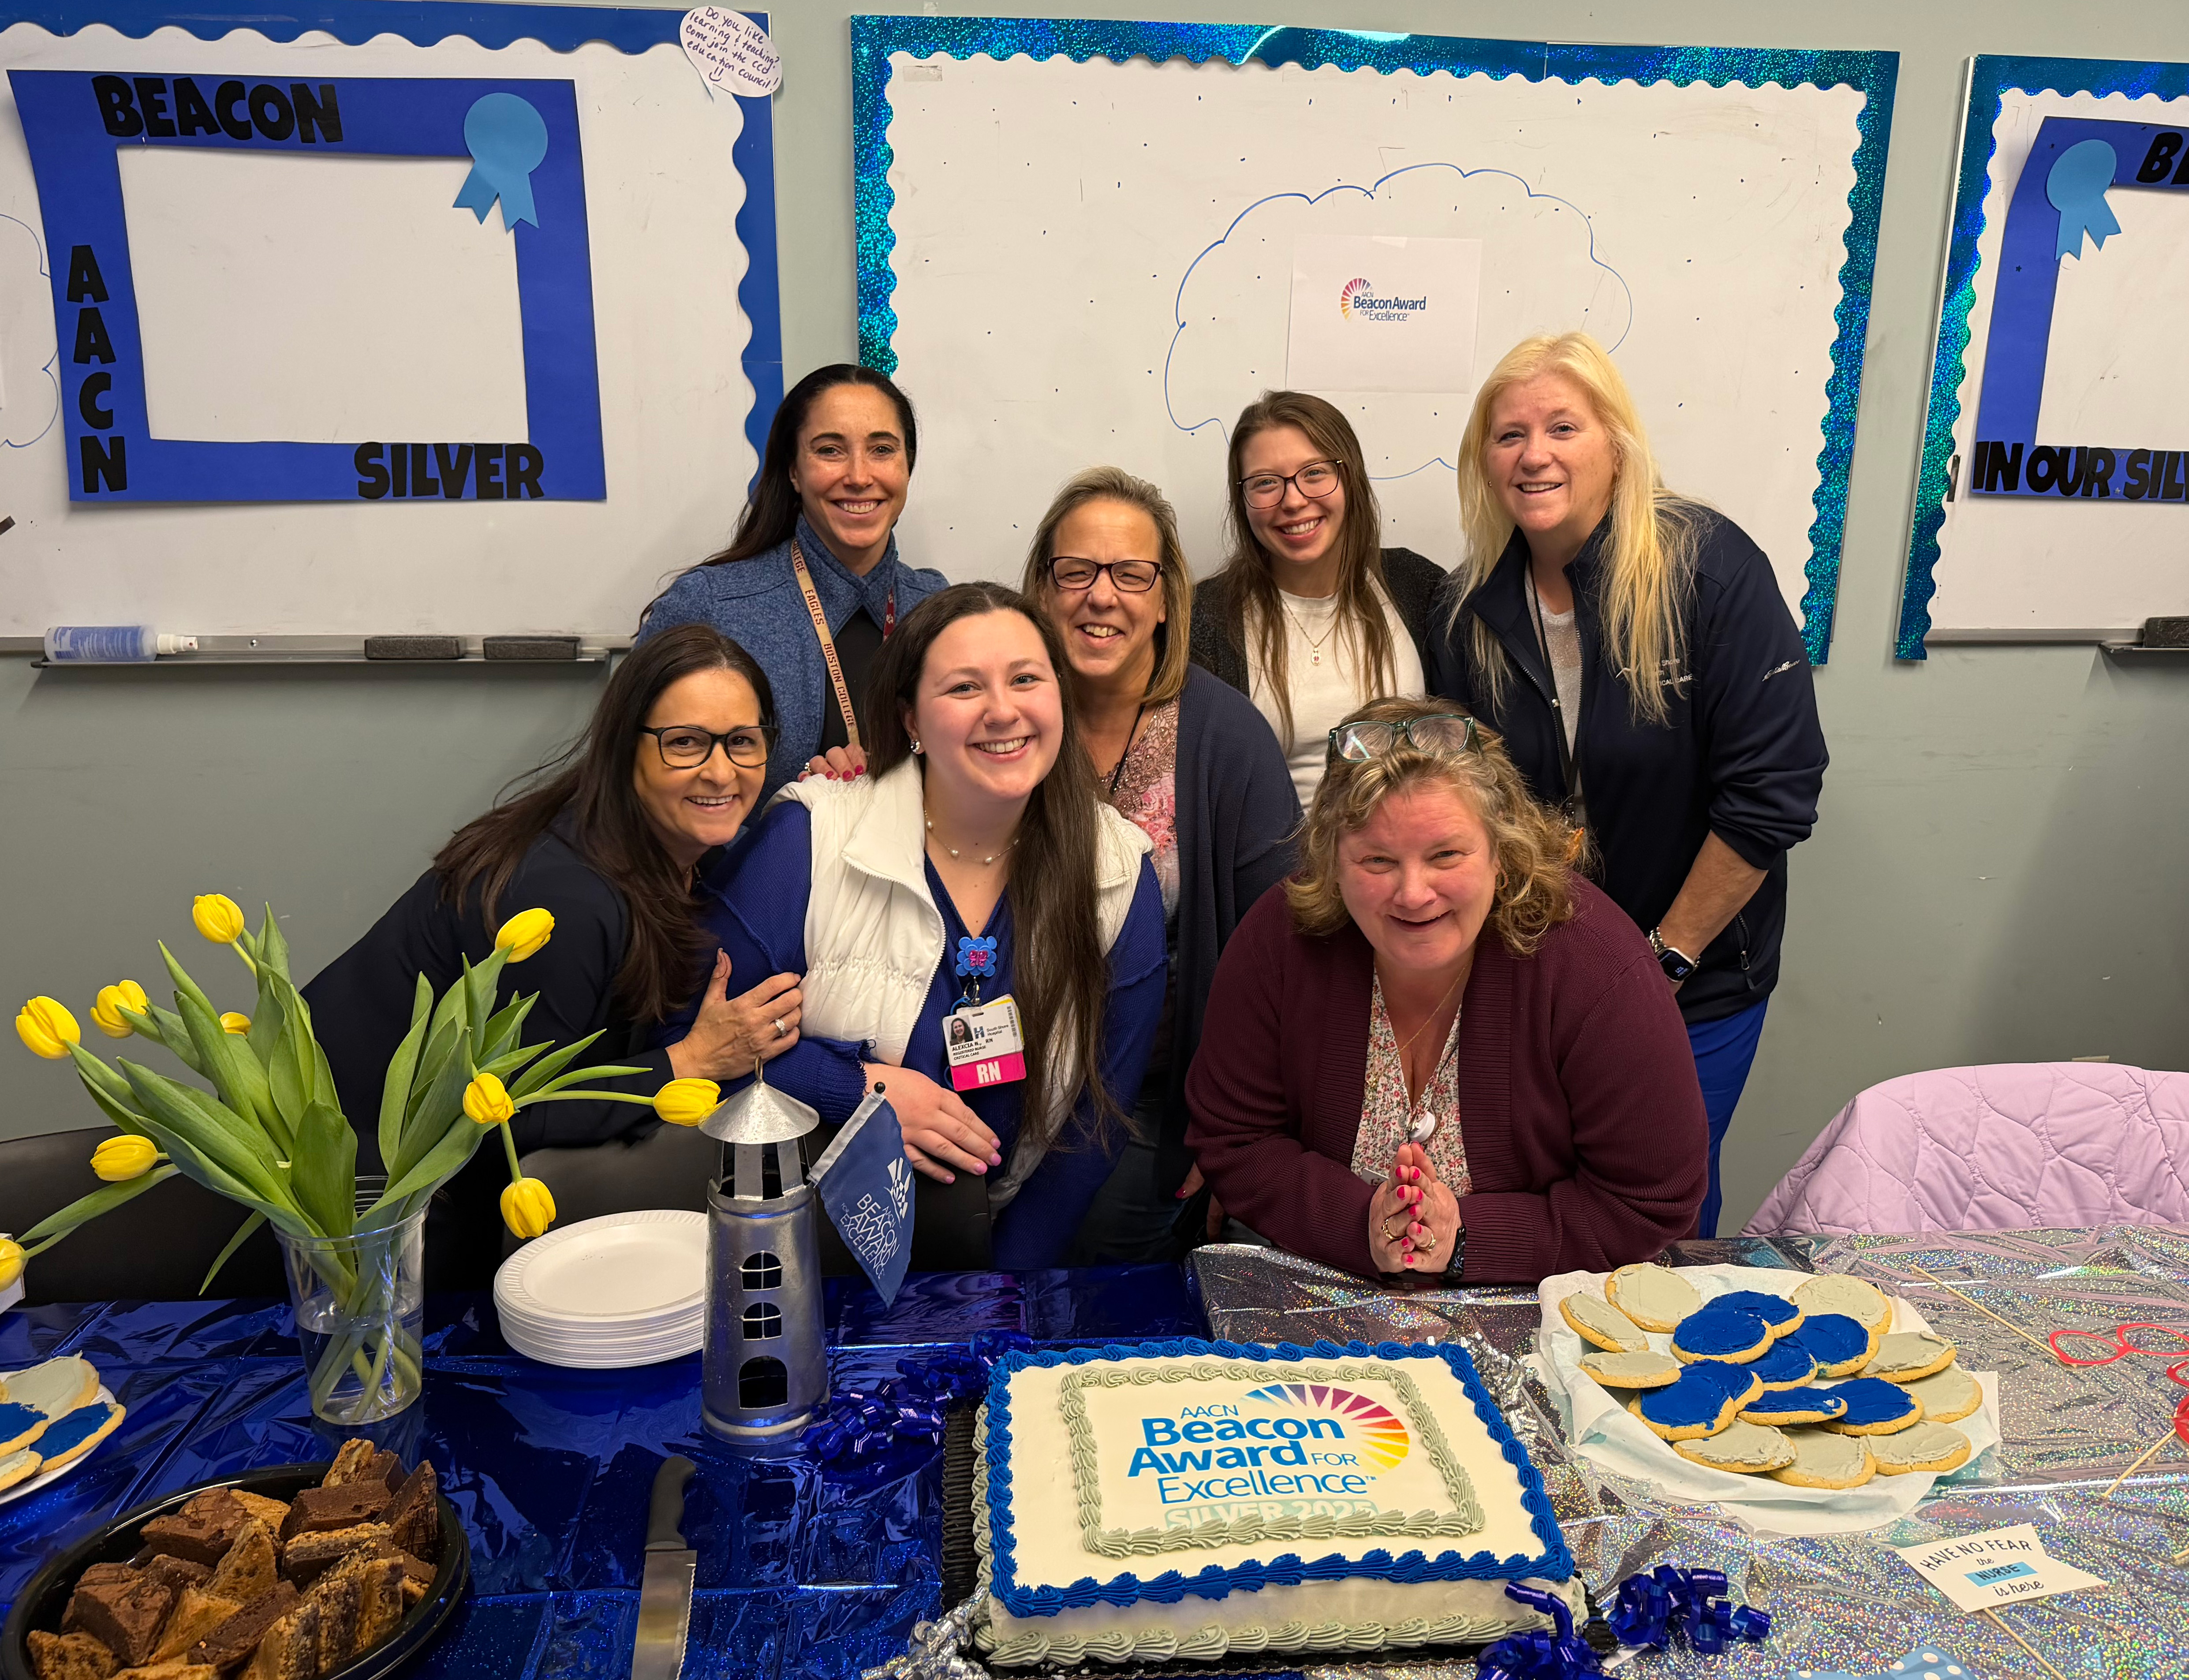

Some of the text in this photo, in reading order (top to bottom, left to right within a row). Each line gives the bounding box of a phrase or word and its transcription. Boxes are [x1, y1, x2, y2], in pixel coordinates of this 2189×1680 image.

[689, 11, 730, 45] learning
[722, 16, 741, 32] you
[744, 26, 764, 44] like
[687, 41, 735, 71] education
[706, 37, 728, 53] join
[732, 51, 746, 63] the
[91, 75, 344, 144] BEACON
[353, 441, 545, 499] SILVER
[1972, 441, 2189, 502] IN OUR SIL
[805, 589, 825, 625] EAGLES
[824, 643, 842, 683] BOSTON
[837, 686, 855, 728] COLLEGE
[976, 1060, 1001, 1084] RN
[850, 1213, 891, 1268] AWARD
[857, 1193, 900, 1258] BEACON
[840, 1213, 885, 1279] EXCELLENCE
[1180, 1404, 1240, 1419] AACN
[1141, 1417, 1345, 1447] Beacon
[1127, 1440, 1360, 1478] Award FOR
[1919, 1539, 2033, 1571] HAVE NO FEAR
[1976, 1556, 1995, 1566] the
[1976, 1563, 2022, 1581] NURSE
[1992, 1579, 2044, 1597] is here
